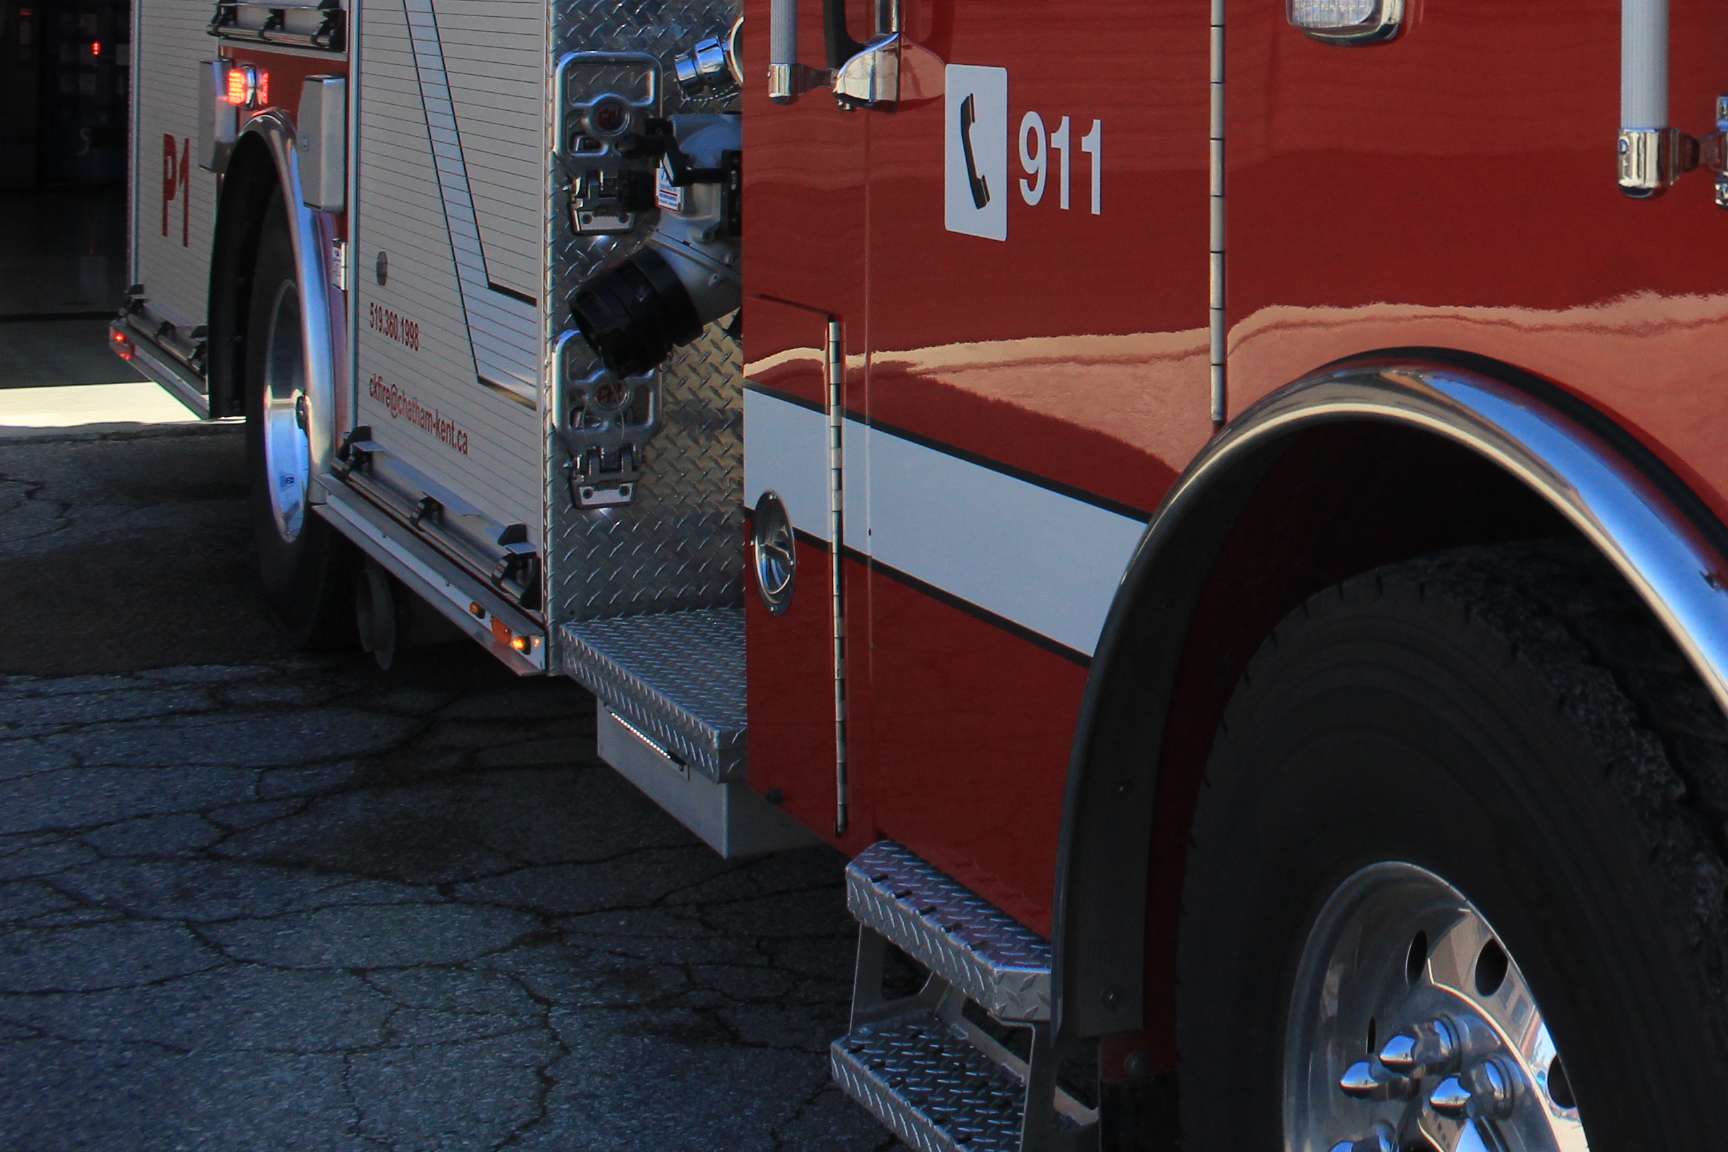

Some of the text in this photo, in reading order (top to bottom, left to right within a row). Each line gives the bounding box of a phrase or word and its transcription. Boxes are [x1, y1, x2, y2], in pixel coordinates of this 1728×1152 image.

[161, 132, 190, 248] P1
[1018, 110, 1102, 216] 911
[369, 301, 420, 352] 519.360.1998
[369, 373, 469, 456] ckfire@chatham-kent.ca
